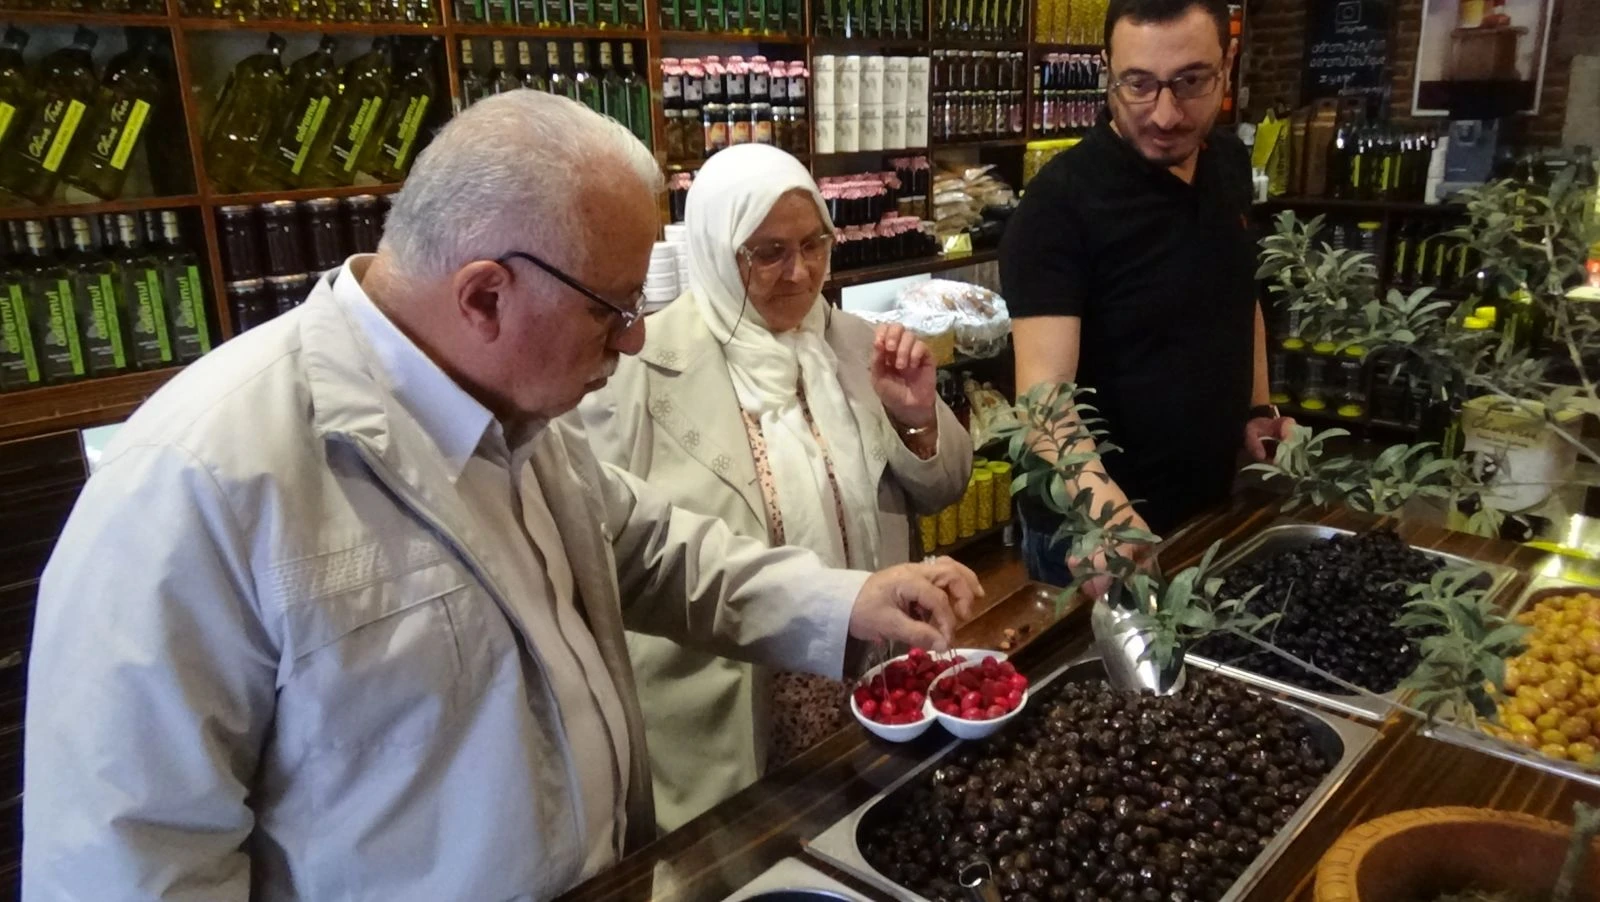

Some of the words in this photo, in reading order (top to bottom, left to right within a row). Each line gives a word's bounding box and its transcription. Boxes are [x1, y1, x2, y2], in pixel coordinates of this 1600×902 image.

[29, 127, 51, 157] Olive
[44, 100, 64, 123] Tree
[97, 127, 118, 156] Olive
[111, 100, 129, 122] Tree
[45, 291, 67, 346] adramut
[87, 285, 108, 339] adramut
[134, 281, 155, 334] adramut
[176, 276, 196, 328] adramut
